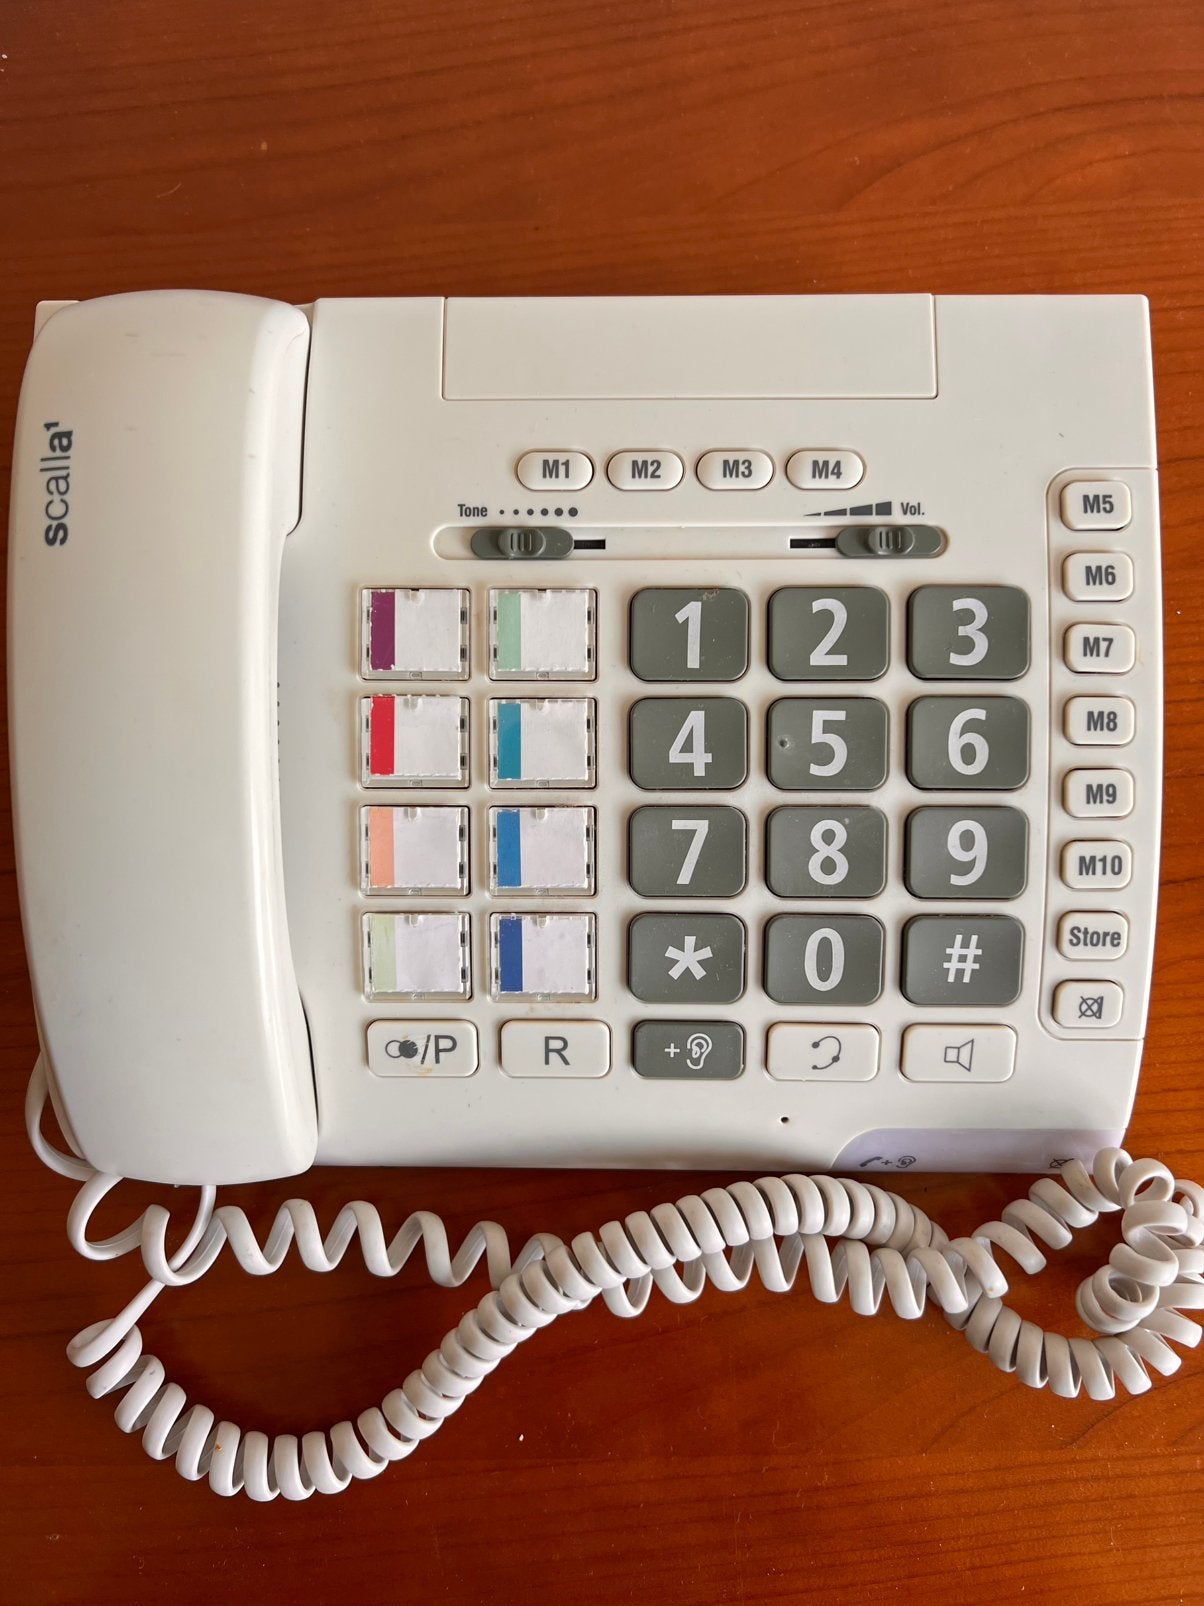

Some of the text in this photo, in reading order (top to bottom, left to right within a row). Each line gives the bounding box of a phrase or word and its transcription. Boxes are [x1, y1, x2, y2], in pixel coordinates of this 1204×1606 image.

[543, 459, 569, 478] M1
[632, 460, 661, 479] M2
[723, 459, 752, 478] M3
[812, 460, 842, 479] M4
[458, 504, 487, 517] Tone
[900, 501, 925, 516] Vol.
[1082, 494, 1115, 515] M5
[1084, 564, 1117, 586] M6
[675, 601, 701, 668] 1
[810, 599, 847, 665] 2
[950, 598, 988, 666] 3
[1083, 637, 1113, 657] M7
[1087, 711, 1117, 732] M8
[669, 711, 712, 776] 4
[810, 710, 847, 776] 5
[948, 709, 989, 775] 6
[1086, 784, 1116, 804] M9
[672, 820, 708, 884] 7
[808, 820, 848, 885] 8
[947, 820, 987, 885] 9
[1079, 855, 1122, 875] M10
[1069, 926, 1121, 947] Store
[805, 928, 844, 991] 0
[544, 1035, 571, 1066] R
